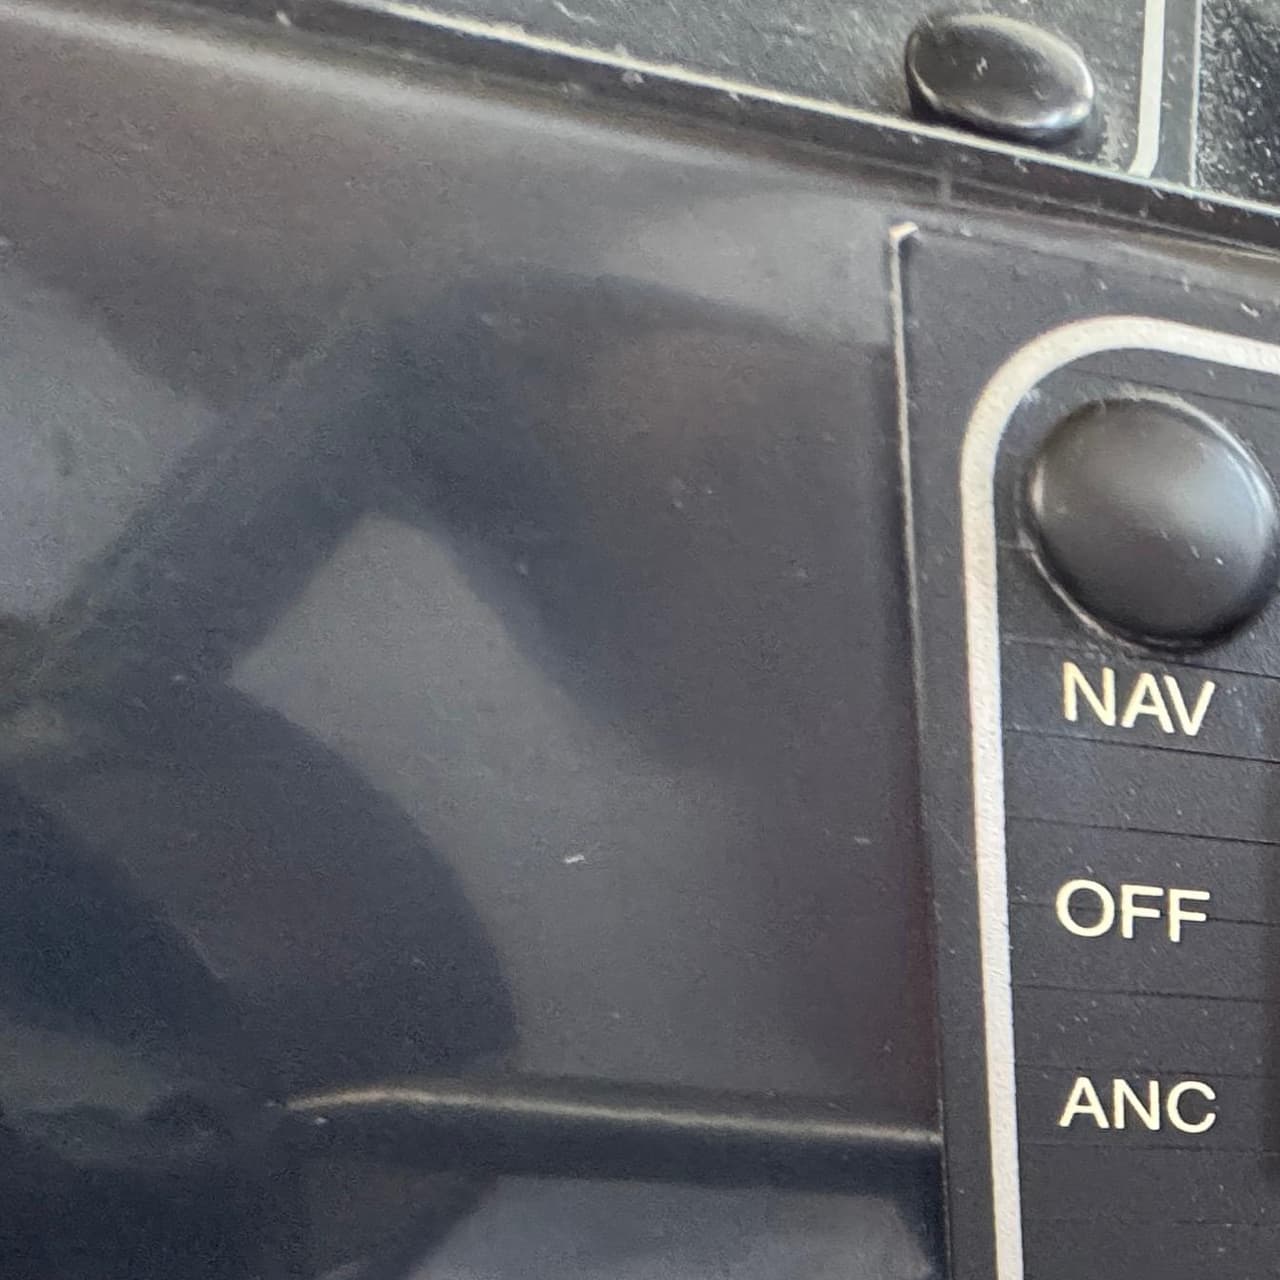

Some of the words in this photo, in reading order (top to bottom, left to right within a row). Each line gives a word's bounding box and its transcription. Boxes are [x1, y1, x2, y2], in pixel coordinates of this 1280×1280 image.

[1062, 661, 1216, 736] NAV
[1055, 879, 1211, 943] OFF
[1058, 1076, 1217, 1133] ANC
